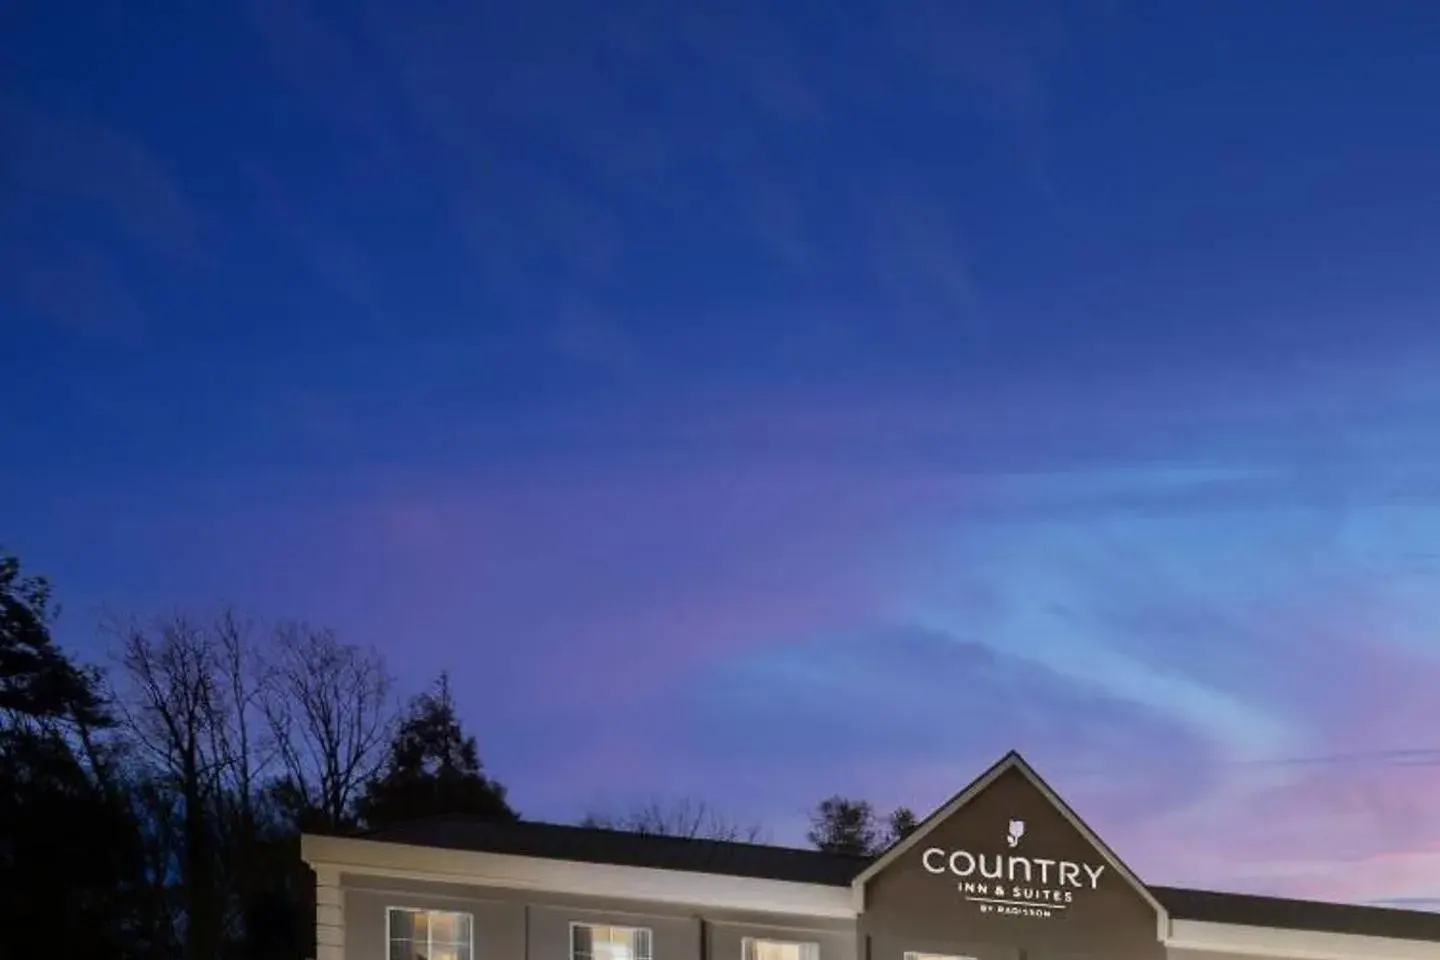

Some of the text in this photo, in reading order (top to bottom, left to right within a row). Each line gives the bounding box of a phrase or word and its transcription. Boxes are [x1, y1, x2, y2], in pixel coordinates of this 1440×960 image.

[922, 848, 1105, 889] COUNTRY
[958, 882, 1073, 902] INN & SUITES
